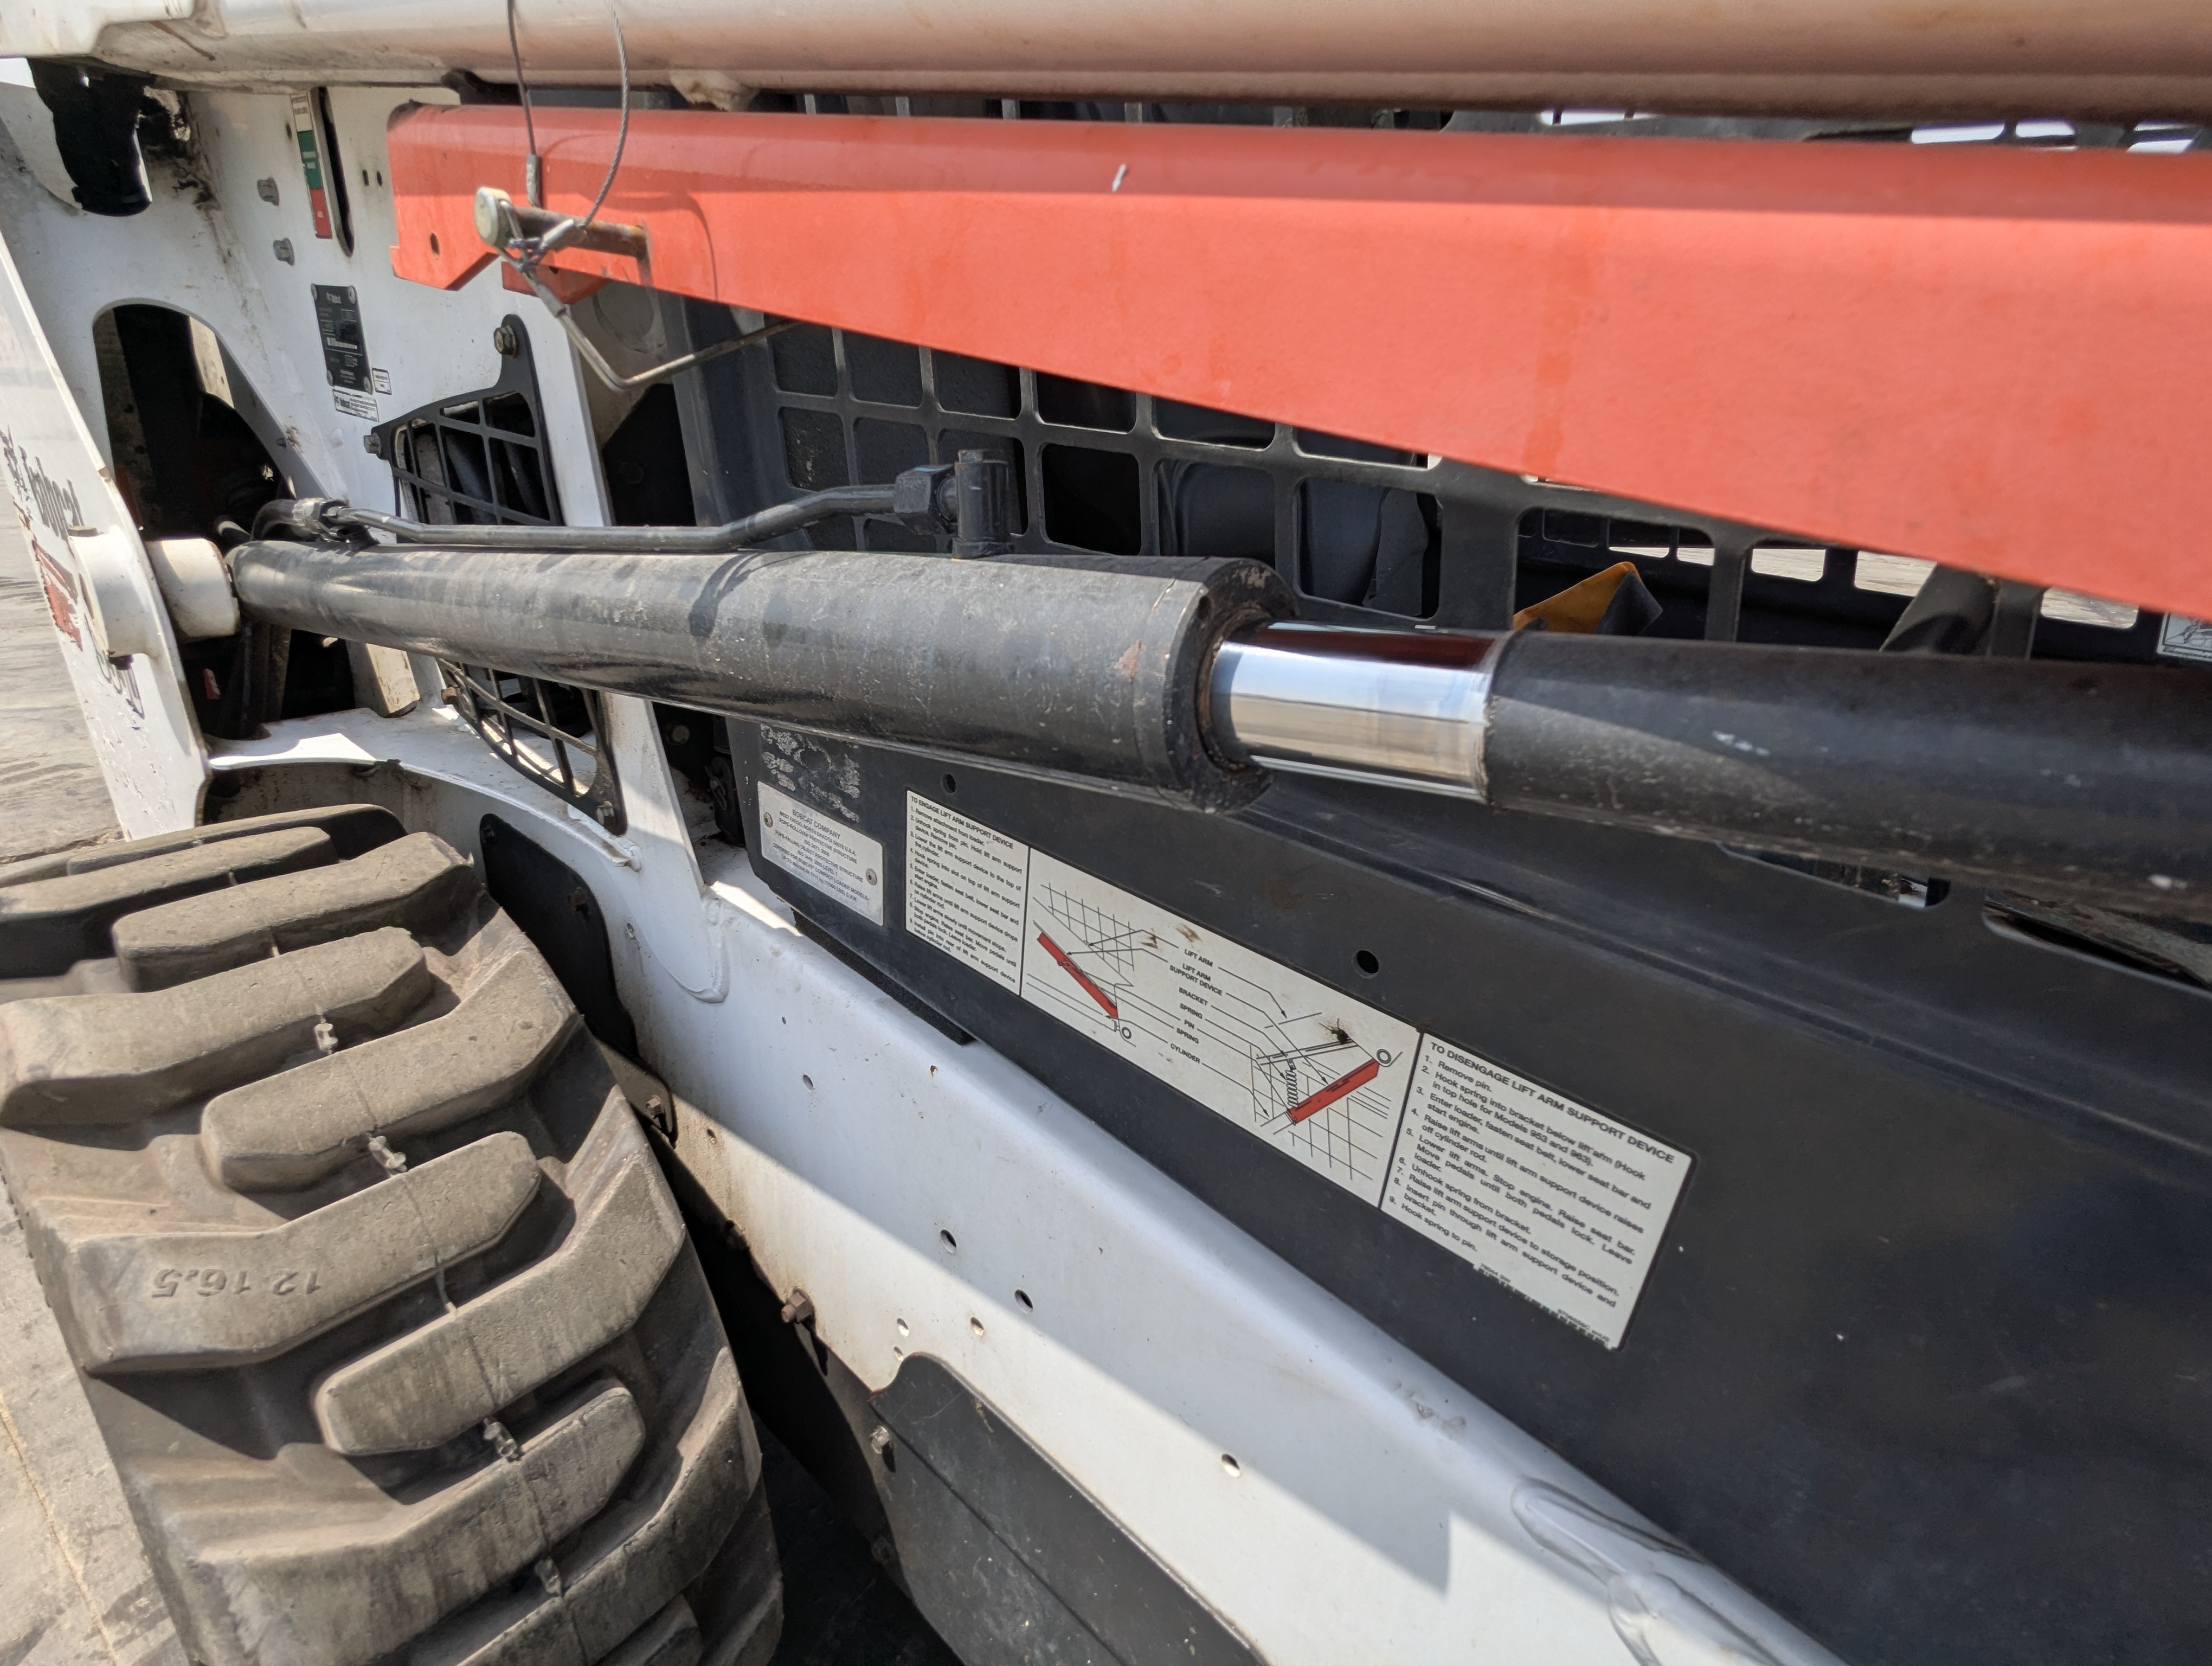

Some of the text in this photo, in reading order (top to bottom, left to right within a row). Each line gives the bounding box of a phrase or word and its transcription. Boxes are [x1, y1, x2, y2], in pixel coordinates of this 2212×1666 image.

[918, 799, 940, 814] ENGAGE
[940, 809, 951, 819] LIFT
[951, 815, 964, 826] ARM
[965, 821, 991, 838] SUPPORT
[992, 834, 1013, 849] DEVICE
[1182, 962, 1211, 982] LIFT ARM
[1184, 948, 1213, 967] LIFT ARM
[1169, 964, 1223, 996] SUPPORT DEVICE
[1178, 986, 1208, 1006] BRACKET
[1179, 1002, 1203, 1020] SPRING
[1184, 1018, 1194, 1029] PIN
[1170, 1042, 1200, 1064] CYLINDER
[1176, 1027, 1199, 1045] SPRING
[1437, 1060, 1474, 1083] Remove
[1474, 1079, 1493, 1093] pin.
[1426, 1102, 1480, 1135] start engine.
[1435, 1071, 1458, 1088] Hook
[1459, 1084, 1488, 1104] spring
[1489, 1098, 1507, 1112] into
[1508, 1107, 1545, 1130] bracket
[1545, 1125, 1577, 1145] below
[1577, 1141, 1593, 1154] lift
[1592, 1149, 1613, 1164] arm
[1442, 1085, 1457, 1099] top
[1458, 1093, 1478, 1108] hole
[1478, 1104, 1493, 1116] for
[1494, 1111, 1528, 1133] Models
[1529, 1129, 1548, 1143] 953
[1548, 1139, 1568, 1154] and
[1446, 1049, 1509, 1085] DISENGAGE
[1511, 1080, 1536, 1097] LIFT
[1536, 1093, 1565, 1111] ARM
[1566, 1106, 1625, 1139] SUPPORT
[1626, 1135, 1675, 1164] DEVICE
[1414, 1152, 1442, 1172] loader.
[1421, 1124, 1487, 1163] off cylinder rod.
[1429, 1092, 1453, 1109] Enter
[1453, 1104, 1483, 1126] loader,
[1484, 1120, 1514, 1140] fasten
[1513, 1136, 1535, 1151] seat
[1535, 1145, 1557, 1163] belt,
[1558, 1157, 1587, 1176] lower
[1587, 1173, 1610, 1189] seat
[1611, 1184, 1630, 1199] bar
[1630, 1195, 1651, 1210] and
[1424, 1113, 1448, 1132] Raise
[1449, 1126, 1461, 1138] lift
[1461, 1135, 1484, 1150] arms
[1484, 1145, 1504, 1161] until
[1505, 1156, 1518, 1168] lift
[1518, 1164, 1538, 1178] arm
[1539, 1175, 1577, 1199] support
[1578, 1195, 1612, 1216] device
[1612, 1213, 1644, 1234] raises
[1404, 1192, 1436, 1216] bracket.
[1411, 1163, 1443, 1186] Unhook
[1444, 1182, 1472, 1202] spring
[1472, 1197, 1494, 1213] from
[1494, 1209, 1532, 1234] bracket.
[1416, 1143, 1633, 1265] Move pedals until both pedals lock. Leave
[1418, 1134, 1445, 1153] Lower
[1448, 1150, 1461, 1162] lift
[1463, 1159, 1488, 1177] arms.
[1492, 1174, 1515, 1191] Stop
[1519, 1188, 1553, 1212] engine.
[1557, 1208, 1586, 1228] Raise
[1590, 1226, 1612, 1243] seat
[1616, 1240, 1636, 1255] bar.
[1401, 1202, 1423, 1220] Hook
[1423, 1216, 1450, 1236] spring
[1461, 1238, 1477, 1252] pin.
[1406, 1184, 1430, 1202] Insert
[1431, 1199, 1446, 1212] pin
[1449, 1208, 1482, 1232] through
[1485, 1228, 1497, 1240] lift
[1500, 1238, 1518, 1252] arm
[1521, 1250, 1558, 1275] support
[1561, 1273, 1593, 1295] device
[1596, 1293, 1616, 1308] and
[1409, 1173, 1432, 1191] Raise
[1432, 1187, 1444, 1198] lift
[1445, 1195, 1462, 1208] arm
[1462, 1204, 1497, 1228] support
[1497, 1223, 1528, 1245] device
[1540, 1248, 1577, 1273] storage
[1577, 1268, 1619, 1297] position.
